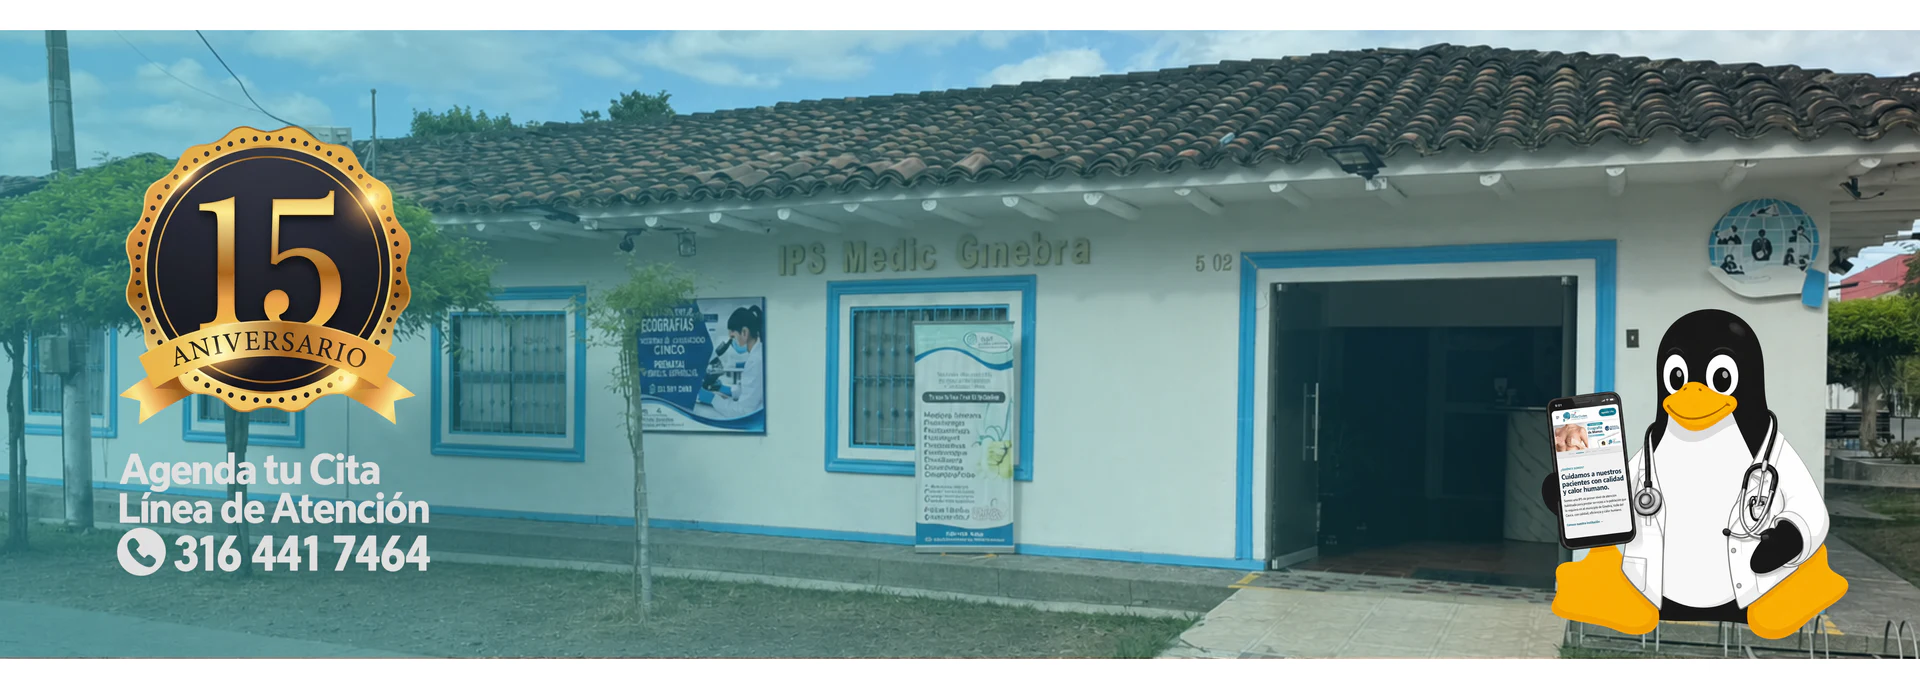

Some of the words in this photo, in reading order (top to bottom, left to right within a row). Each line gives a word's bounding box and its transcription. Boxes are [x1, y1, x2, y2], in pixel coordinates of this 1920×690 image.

[778, 242, 826, 276] IPS
[842, 238, 937, 274] Medic
[956, 231, 1091, 270] Ginebra
[1195, 254, 1206, 272] 5
[1212, 253, 1233, 272] 02
[1561, 471, 1590, 480] Cuidamos
[1596, 468, 1622, 476] nuestros
[1562, 479, 1590, 489] pacientes
[1603, 475, 1624, 483] calidad
[1583, 485, 1609, 493] humano.
